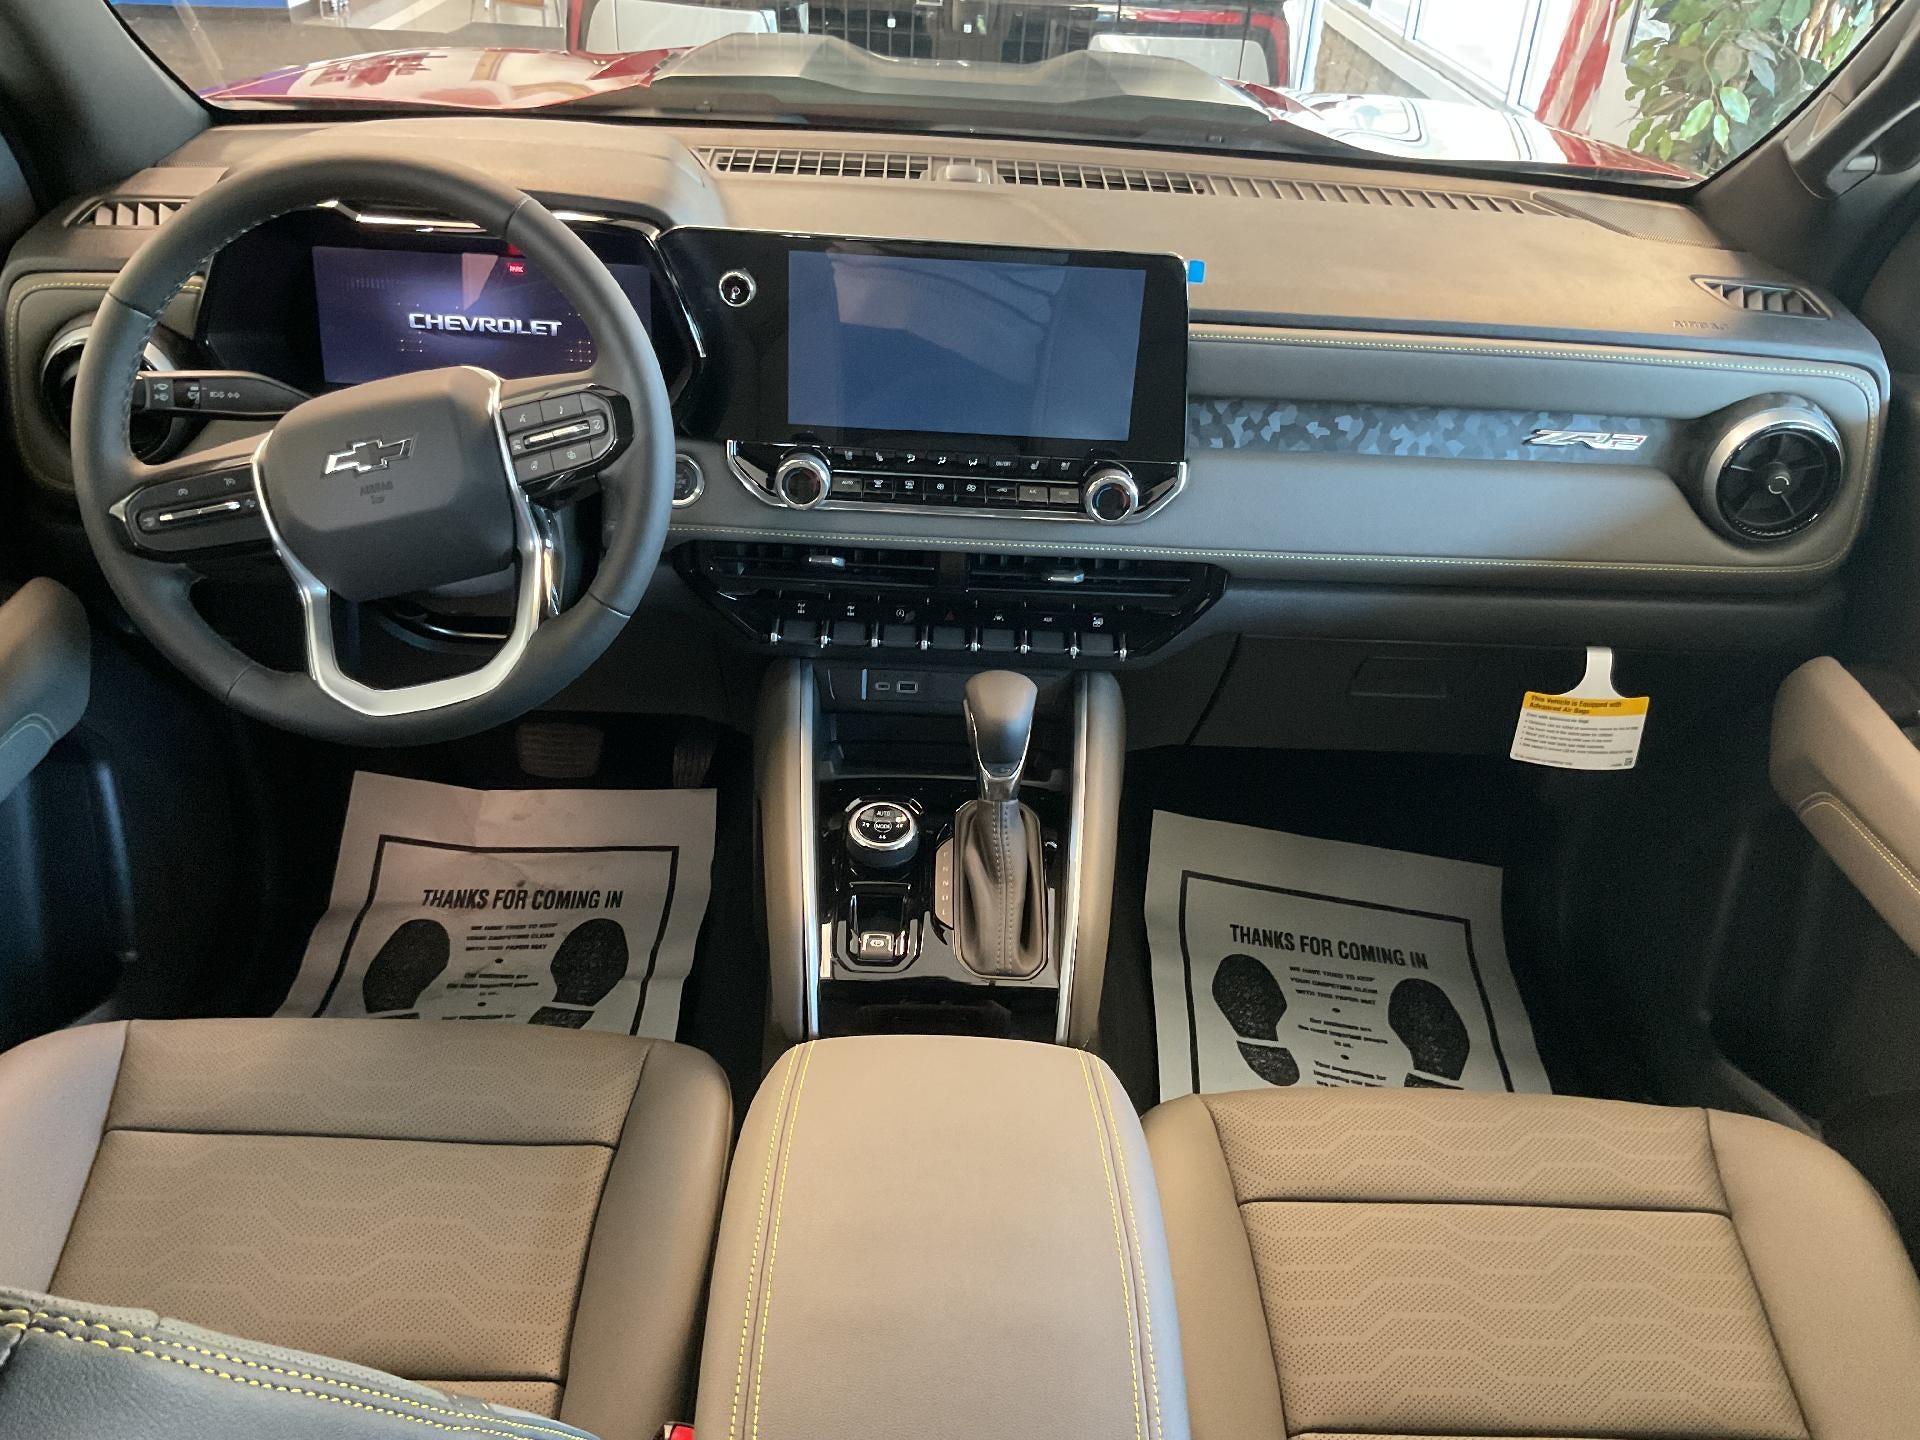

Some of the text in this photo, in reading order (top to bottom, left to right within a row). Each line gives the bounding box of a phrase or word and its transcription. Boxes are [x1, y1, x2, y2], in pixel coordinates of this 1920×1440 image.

[408, 312, 562, 337] CHEVROLET
[1522, 428, 1648, 452] ZR2
[422, 889, 624, 910] THANKS FOR COMING IN
[1229, 923, 1429, 970] THANKS FOR COMING IN
